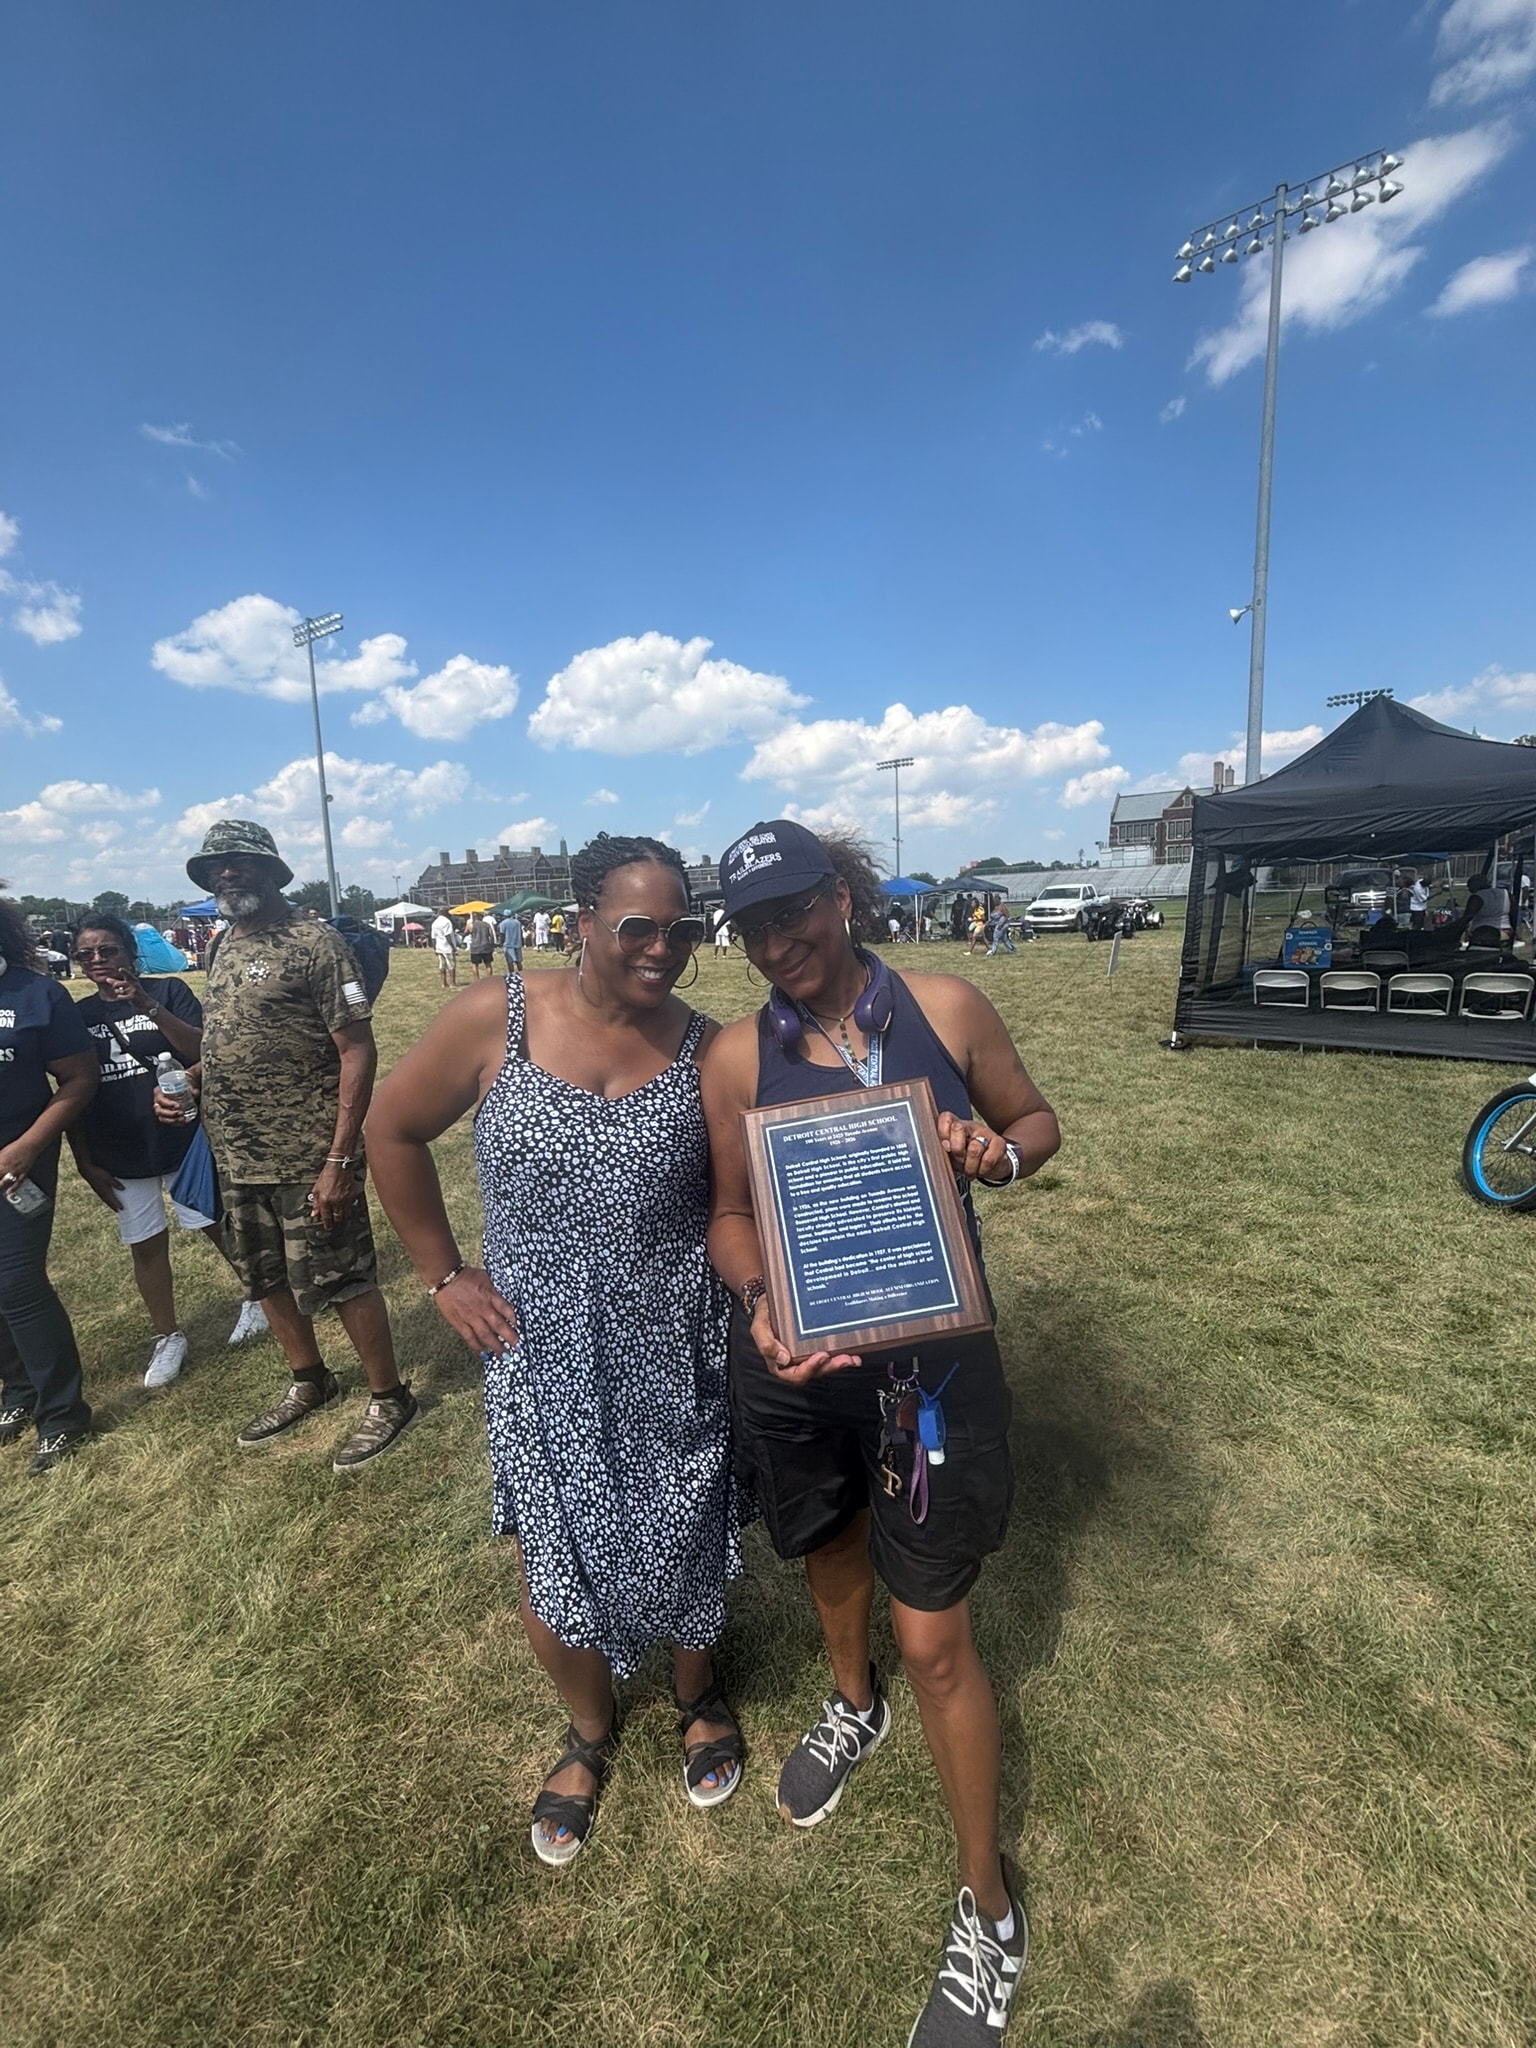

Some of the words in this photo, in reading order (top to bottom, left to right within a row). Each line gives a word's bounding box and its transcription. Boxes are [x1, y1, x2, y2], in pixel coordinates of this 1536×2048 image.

[729, 852, 782, 884] TRAILBLAZERS
[783, 1131, 813, 1142] DETROIT
[815, 1125, 848, 1136] CENTRAL
[848, 1121, 867, 1129] HIGH
[868, 1116, 897, 1125] SCHOOL
[795, 1217, 818, 1225] Roosevelt
[837, 1216, 865, 1225] advocated
[873, 1211, 895, 1219] preserve
[842, 1253, 868, 1262] dedication
[902, 1242, 930, 1252] proclaimed
[806, 1273, 842, 1284] development
